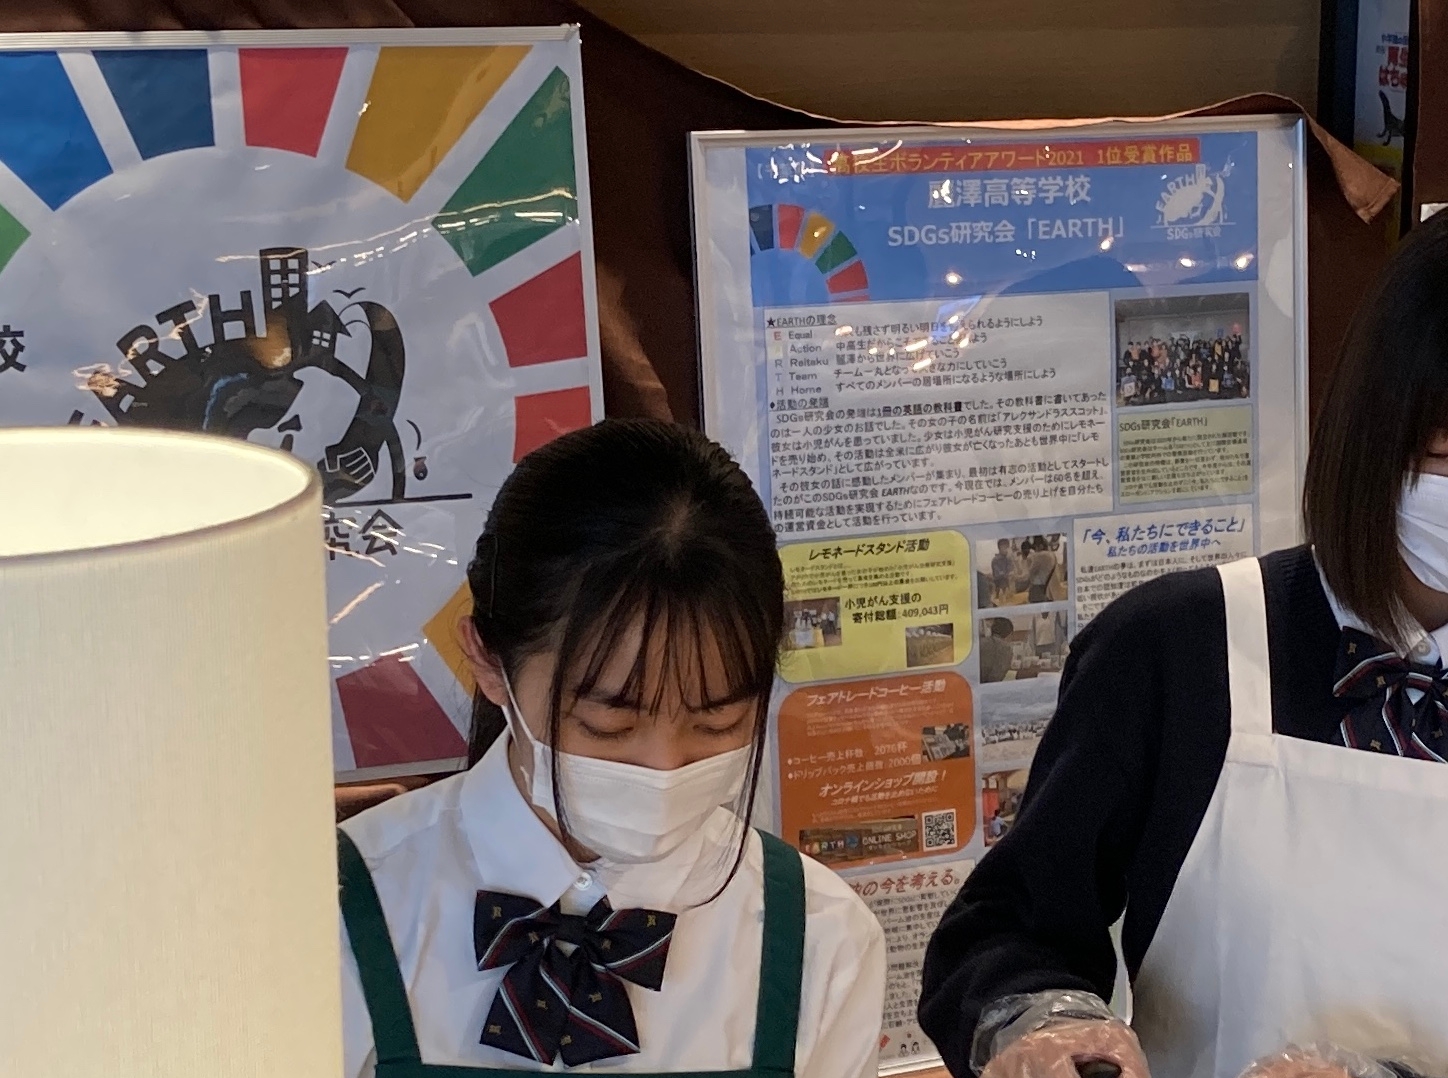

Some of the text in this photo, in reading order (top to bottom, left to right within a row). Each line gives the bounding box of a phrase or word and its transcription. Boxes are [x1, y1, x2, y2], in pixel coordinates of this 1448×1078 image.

[788, 330, 813, 340] Equal
[789, 344, 822, 353] Action
[67, 289, 256, 428] ARTH
[789, 372, 818, 381] Team
[790, 385, 822, 394] Home
